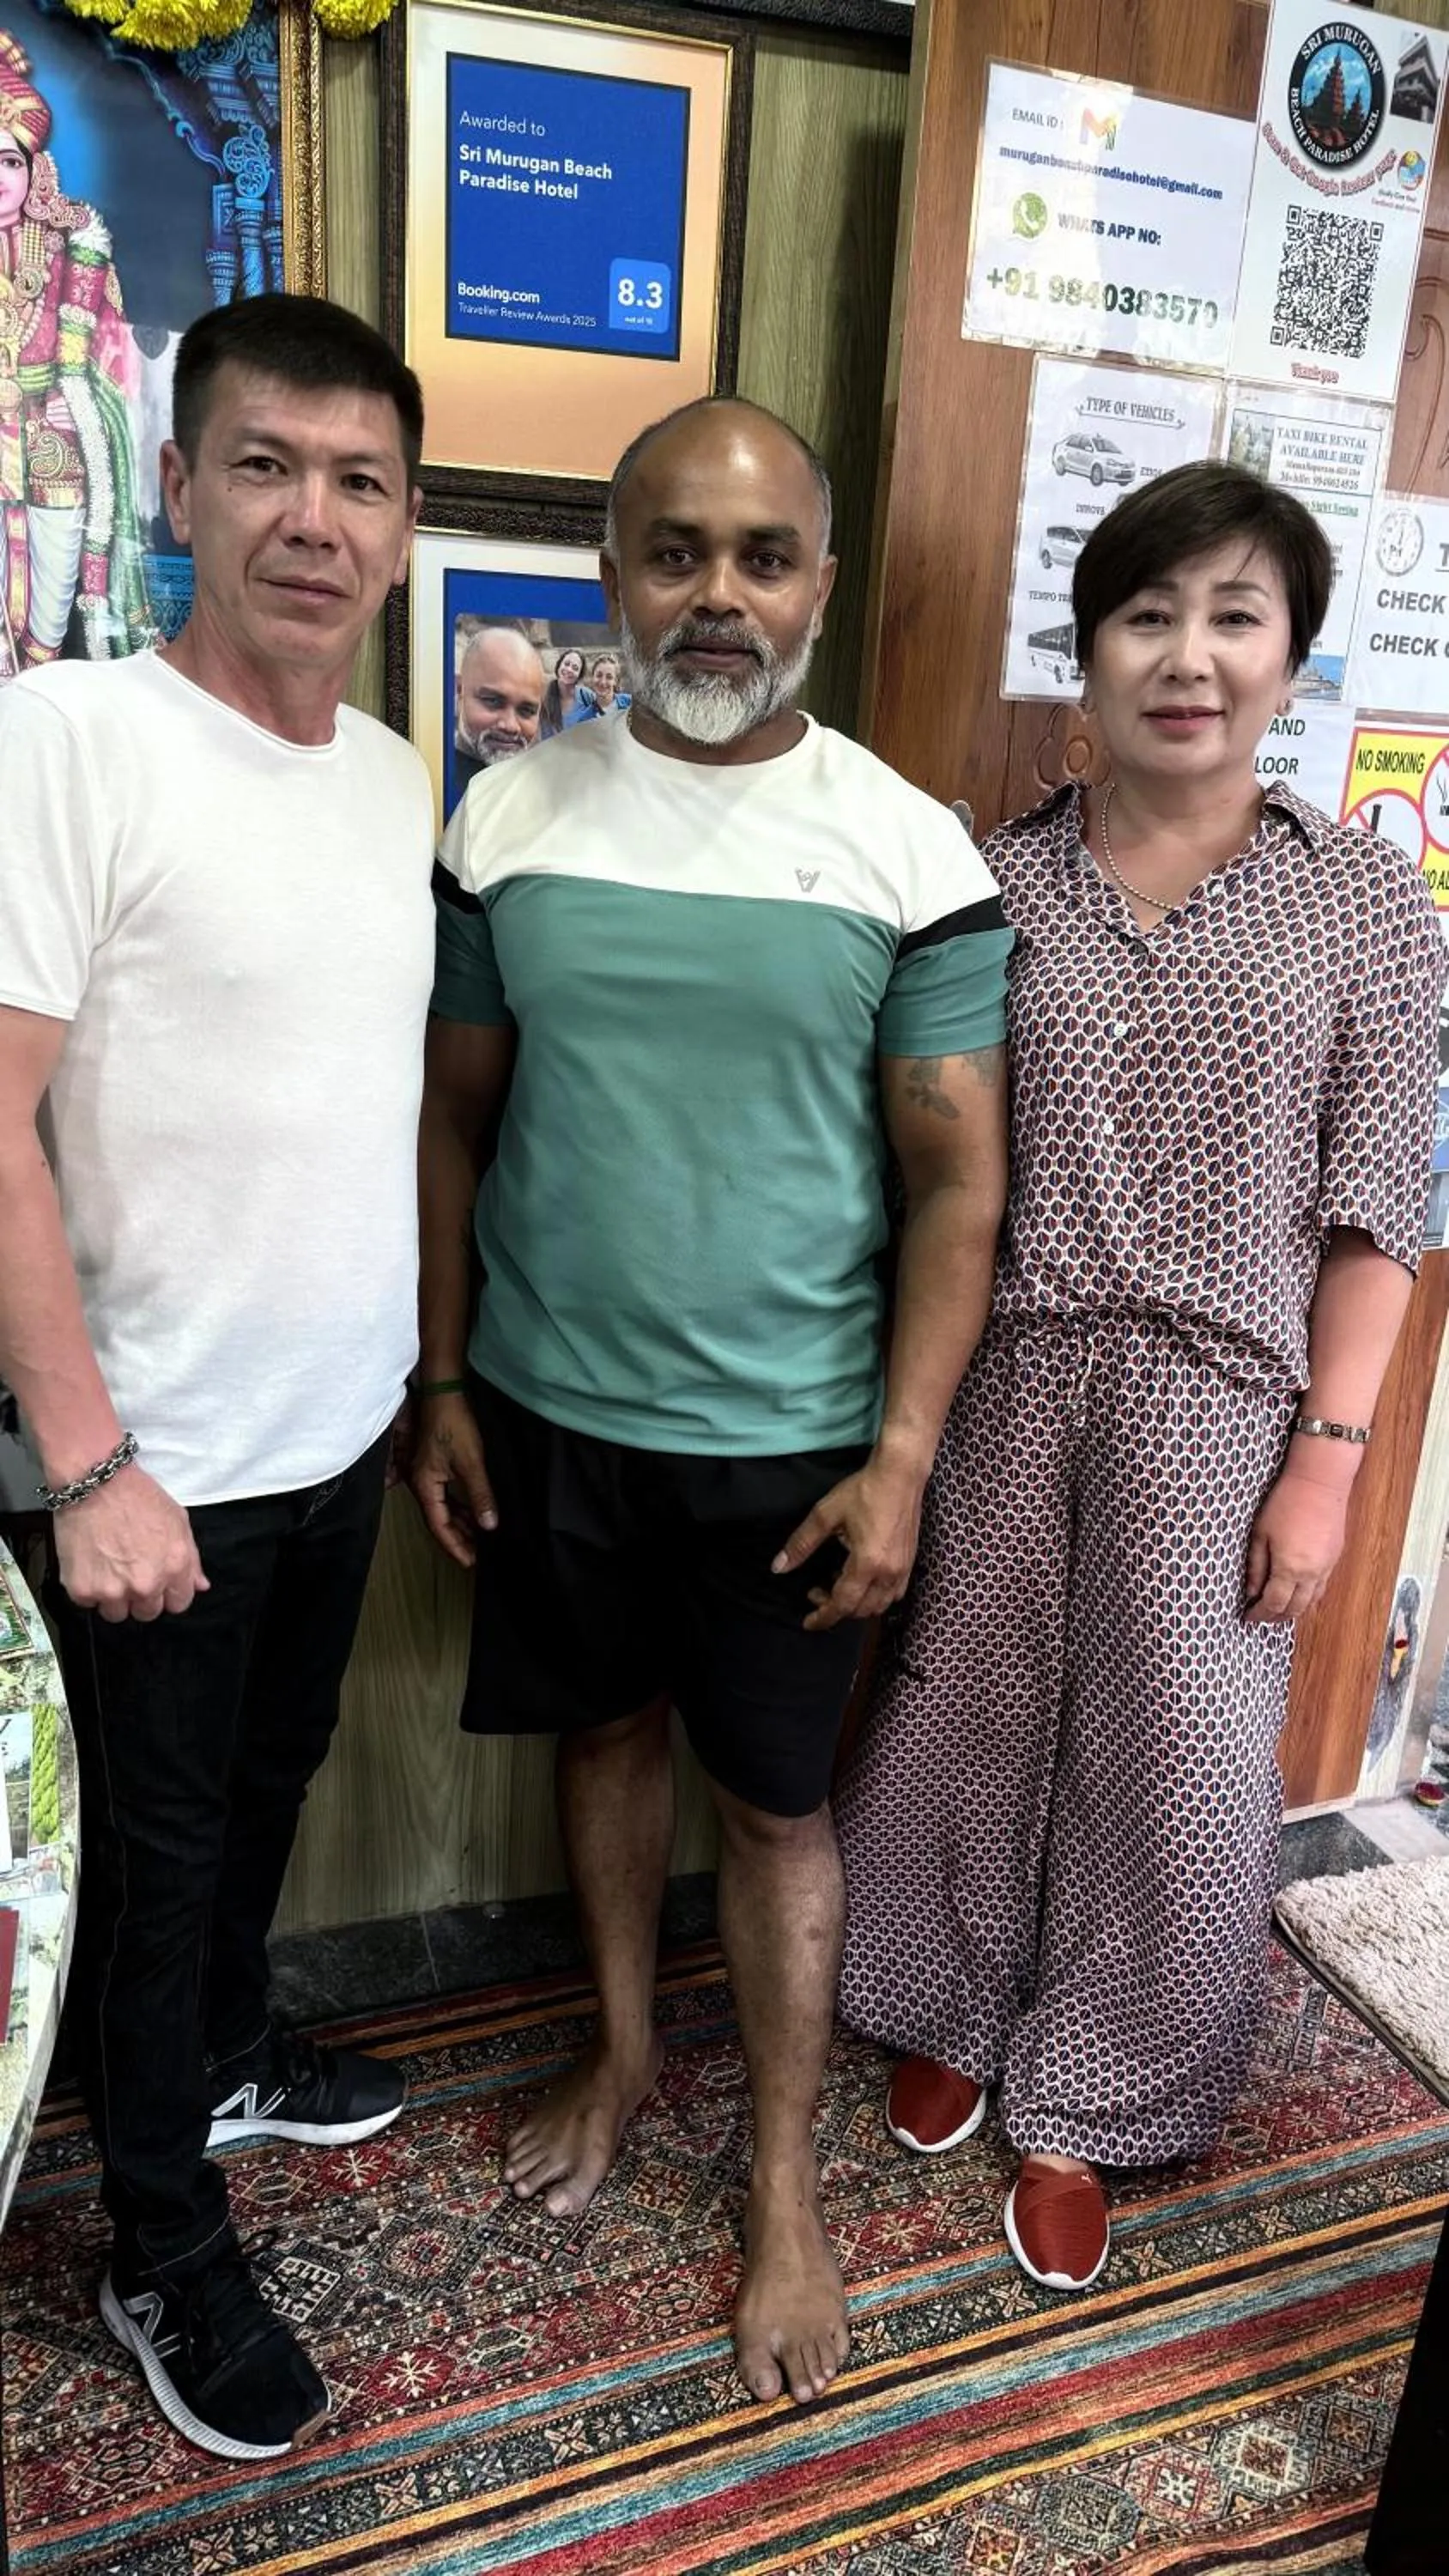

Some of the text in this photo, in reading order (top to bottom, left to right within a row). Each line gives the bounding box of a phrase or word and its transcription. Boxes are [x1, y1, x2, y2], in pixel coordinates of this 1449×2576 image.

[1300, 25, 1382, 75] SRI MURUGAN
[459, 110, 546, 137] Awarded to
[1012, 108, 1044, 129] EMAIL
[1290, 87, 1379, 164] BEACH PARADISE HOTEL
[459, 144, 613, 180] Sri Murugan Beach
[459, 169, 579, 199] Paradise Hotel
[1058, 213, 1161, 246] WHATS APP NO:
[458, 282, 541, 304] Booking.com
[618, 277, 664, 309] 8.3
[987, 267, 1040, 301] +91
[458, 302, 597, 328] Traveller Review Awards 2025
[1086, 397, 1175, 422] TYPE OF VEHICLES
[1277, 426, 1367, 450] TAXI BIKE RENTAL
[1280, 444, 1365, 465] AVAILABLE HERE
[1377, 588, 1446, 615] CHECK
[1369, 633, 1440, 657] CHECK
[1268, 718, 1306, 737] AND
[1254, 756, 1299, 775] LOOR
[1355, 749, 1426, 775] NO SMOKING
